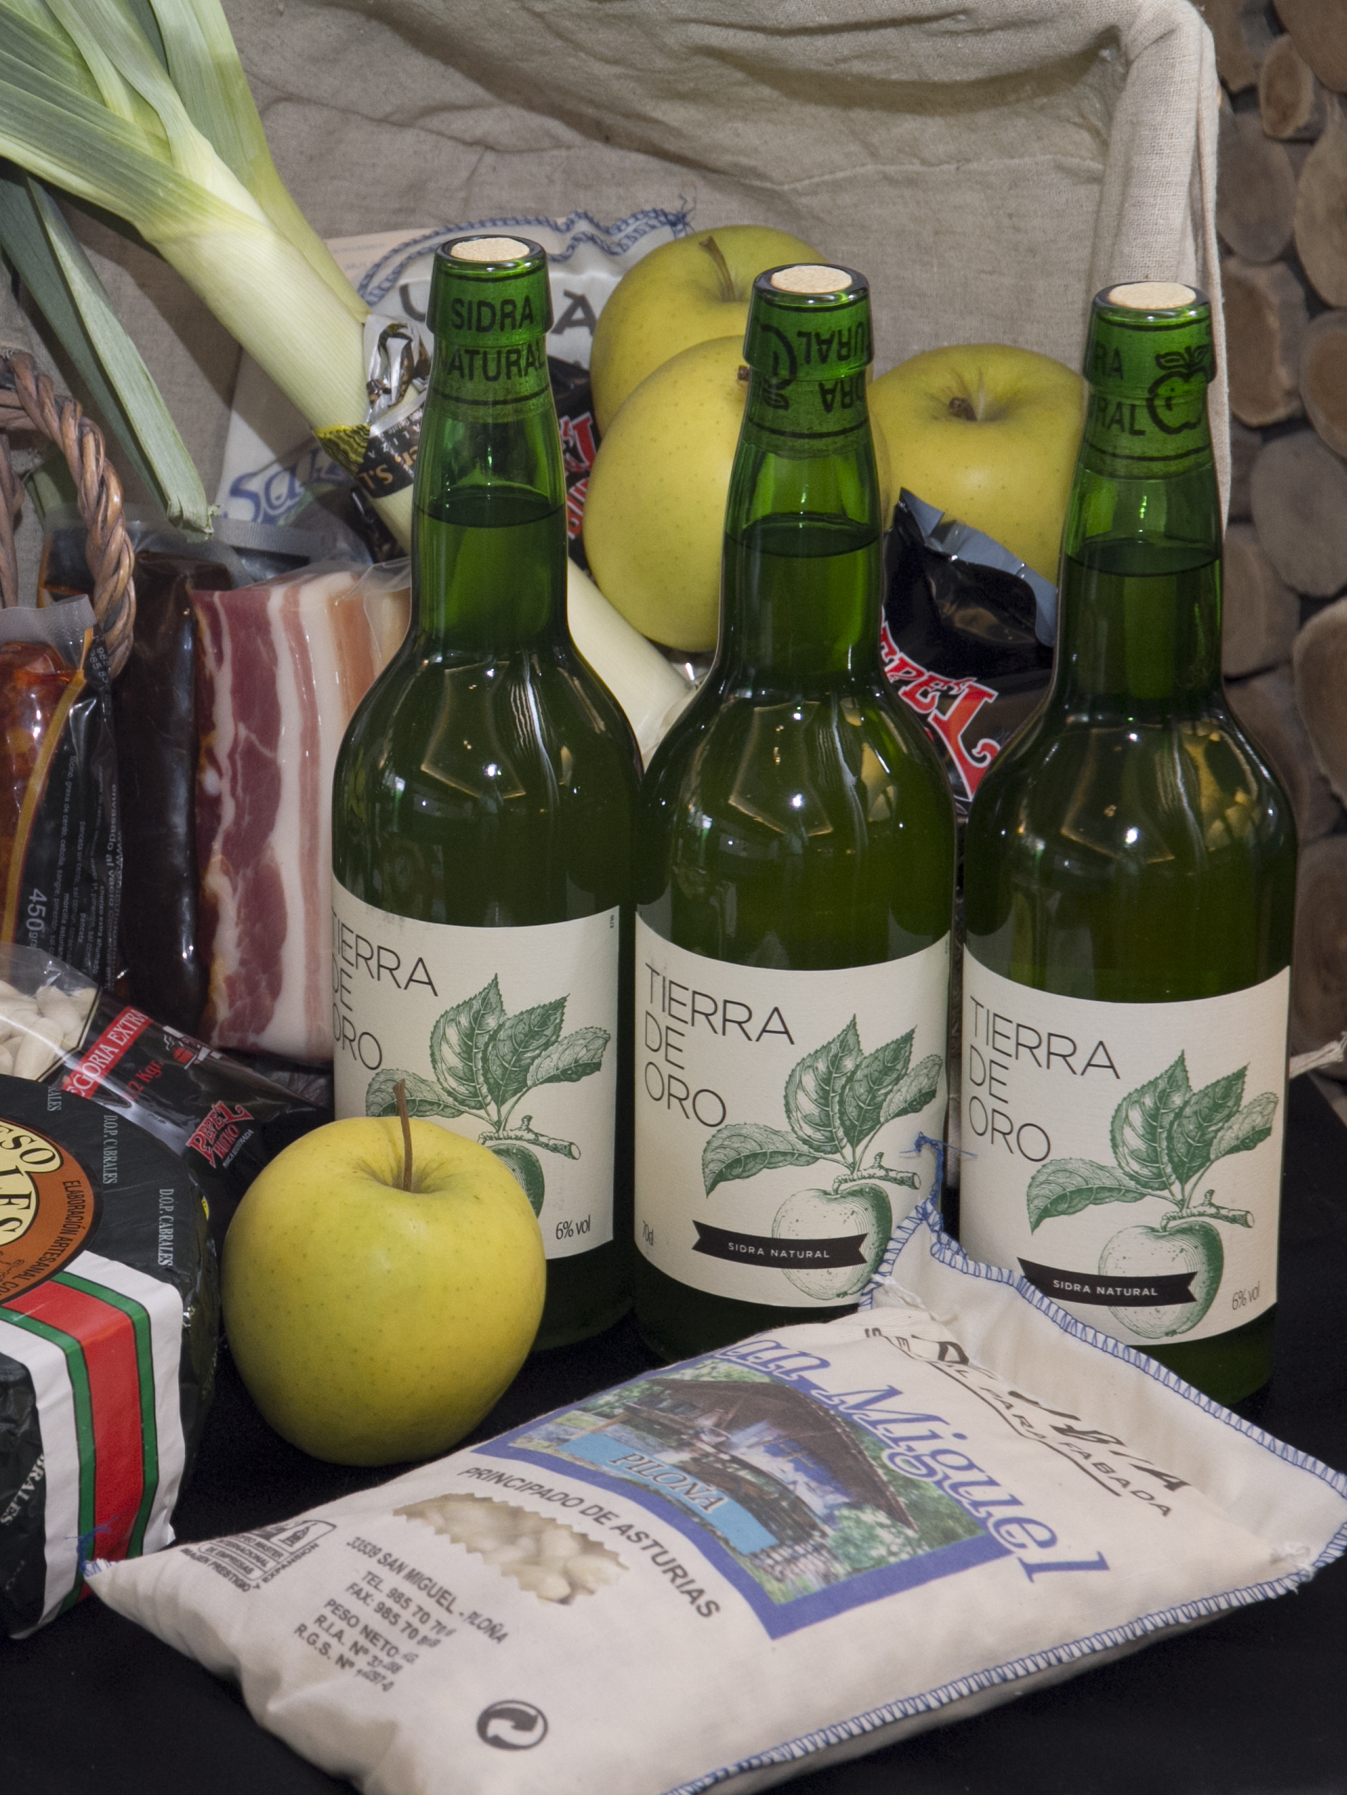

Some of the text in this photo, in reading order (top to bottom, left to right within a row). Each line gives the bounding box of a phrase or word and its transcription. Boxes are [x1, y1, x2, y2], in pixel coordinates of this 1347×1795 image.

[451, 295, 535, 333] SIDRA
[54, 755, 76, 896] tocino, grasa de cerdo, cebolla, sangre,
[77, 821, 86, 850] panceta
[107, 784, 117, 850] envasado
[62, 893, 70, 924] morcilla
[78, 913, 87, 943] panceta
[92, 938, 102, 974] ahumado
[108, 1007, 149, 1047] EXTRA
[645, 962, 795, 1046] TIERRA
[333, 1002, 383, 1070] ORO
[644, 1010, 686, 1071] DE
[969, 995, 1121, 1080] TIERRA
[644, 1061, 727, 1128] ORO
[969, 1044, 1009, 1104] DE
[969, 1095, 1051, 1162] ORO
[103, 1139, 118, 1184] CABRALES
[63, 1180, 85, 1235] ELABORACIÓN
[158, 1188, 174, 1266] D.O.P. CABRALES
[555, 1214, 592, 1241] 6% vol
[12, 1236, 73, 1280] ARTESANAL
[728, 1241, 830, 1258] SIDRA NATURAL
[1053, 1279, 1158, 1297] SIDRA NATURAL
[607, 1448, 737, 1515] PILOÑA
[811, 1383, 1113, 1585] Miguel
[1057, 1441, 1172, 1518] FABADA
[208, 1542, 320, 1593] PRESTIGIO EXPANSION
[215, 1550, 255, 1575] EMPRESAS
[457, 1466, 722, 1621] PRINCIPADO DE ASTURIAS
[345, 1582, 375, 1606] FAX:
[373, 1600, 402, 1627] 985
[400, 1621, 420, 1641] 70
[377, 1552, 408, 1576] SAN
[403, 1567, 458, 1616] MIGUEL
[386, 1587, 432, 1625] 985 70
[293, 1622, 331, 1660] R.G.S.
[335, 1653, 356, 1670] Nº
[314, 1613, 370, 1657] R.I.A. Nº
[323, 1597, 360, 1629] PESO
[358, 1623, 399, 1658] NETO
